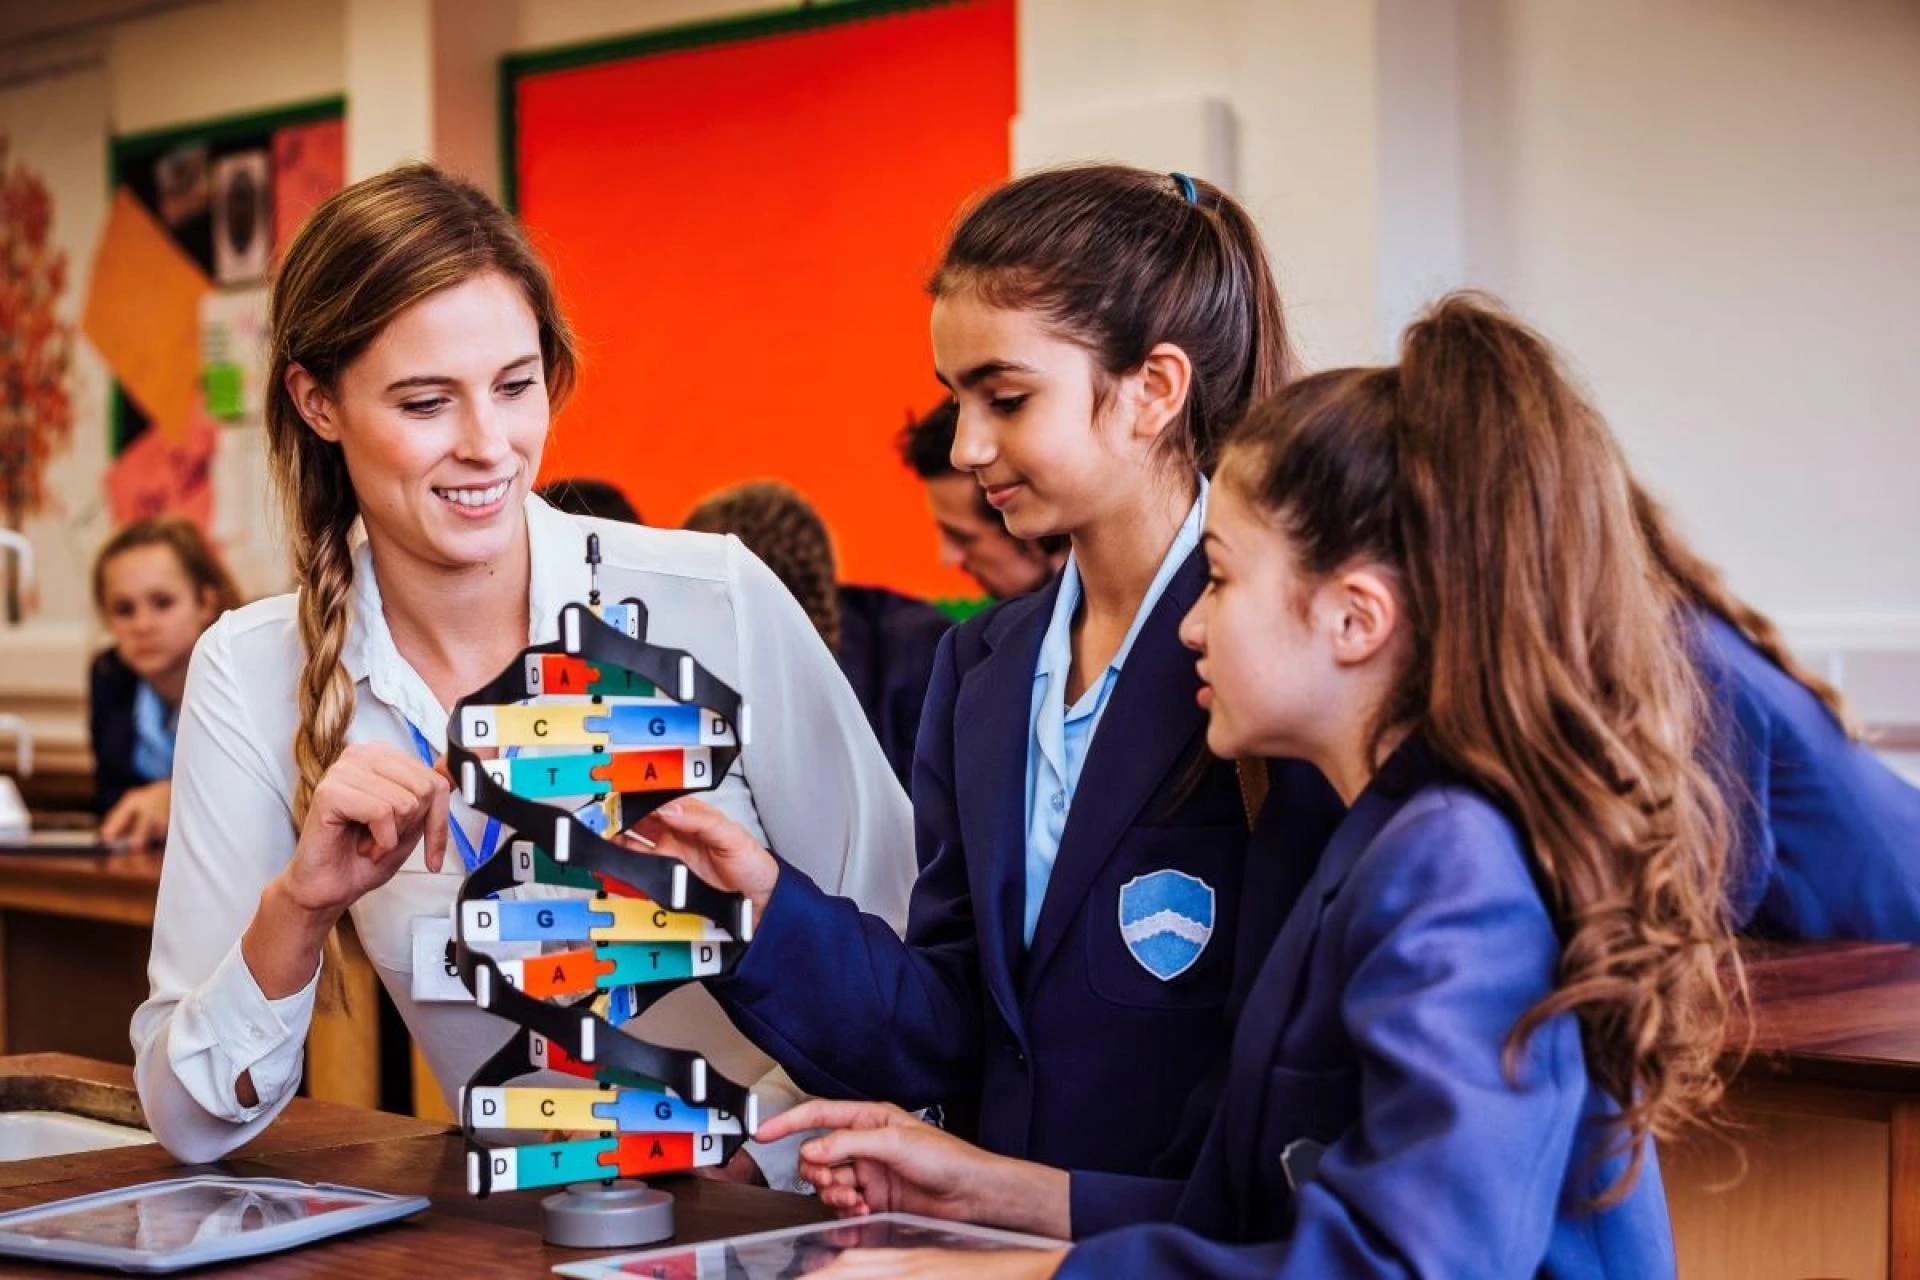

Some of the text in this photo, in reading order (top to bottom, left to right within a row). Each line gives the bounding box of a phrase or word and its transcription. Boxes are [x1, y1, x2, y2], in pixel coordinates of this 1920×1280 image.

[561, 668, 570, 686] A
[475, 717, 726, 737] D C G D
[546, 767, 559, 786] T
[644, 762, 658, 780] A
[693, 761, 705, 777] D
[520, 852, 530, 869] D
[477, 909, 667, 929] D G C
[552, 945, 713, 984] A T D
[535, 1038, 543, 1056] D
[482, 1098, 496, 1116] D
[540, 1099, 555, 1117] C
[655, 1101, 673, 1120] G
[494, 1135, 713, 1175] D T A D
